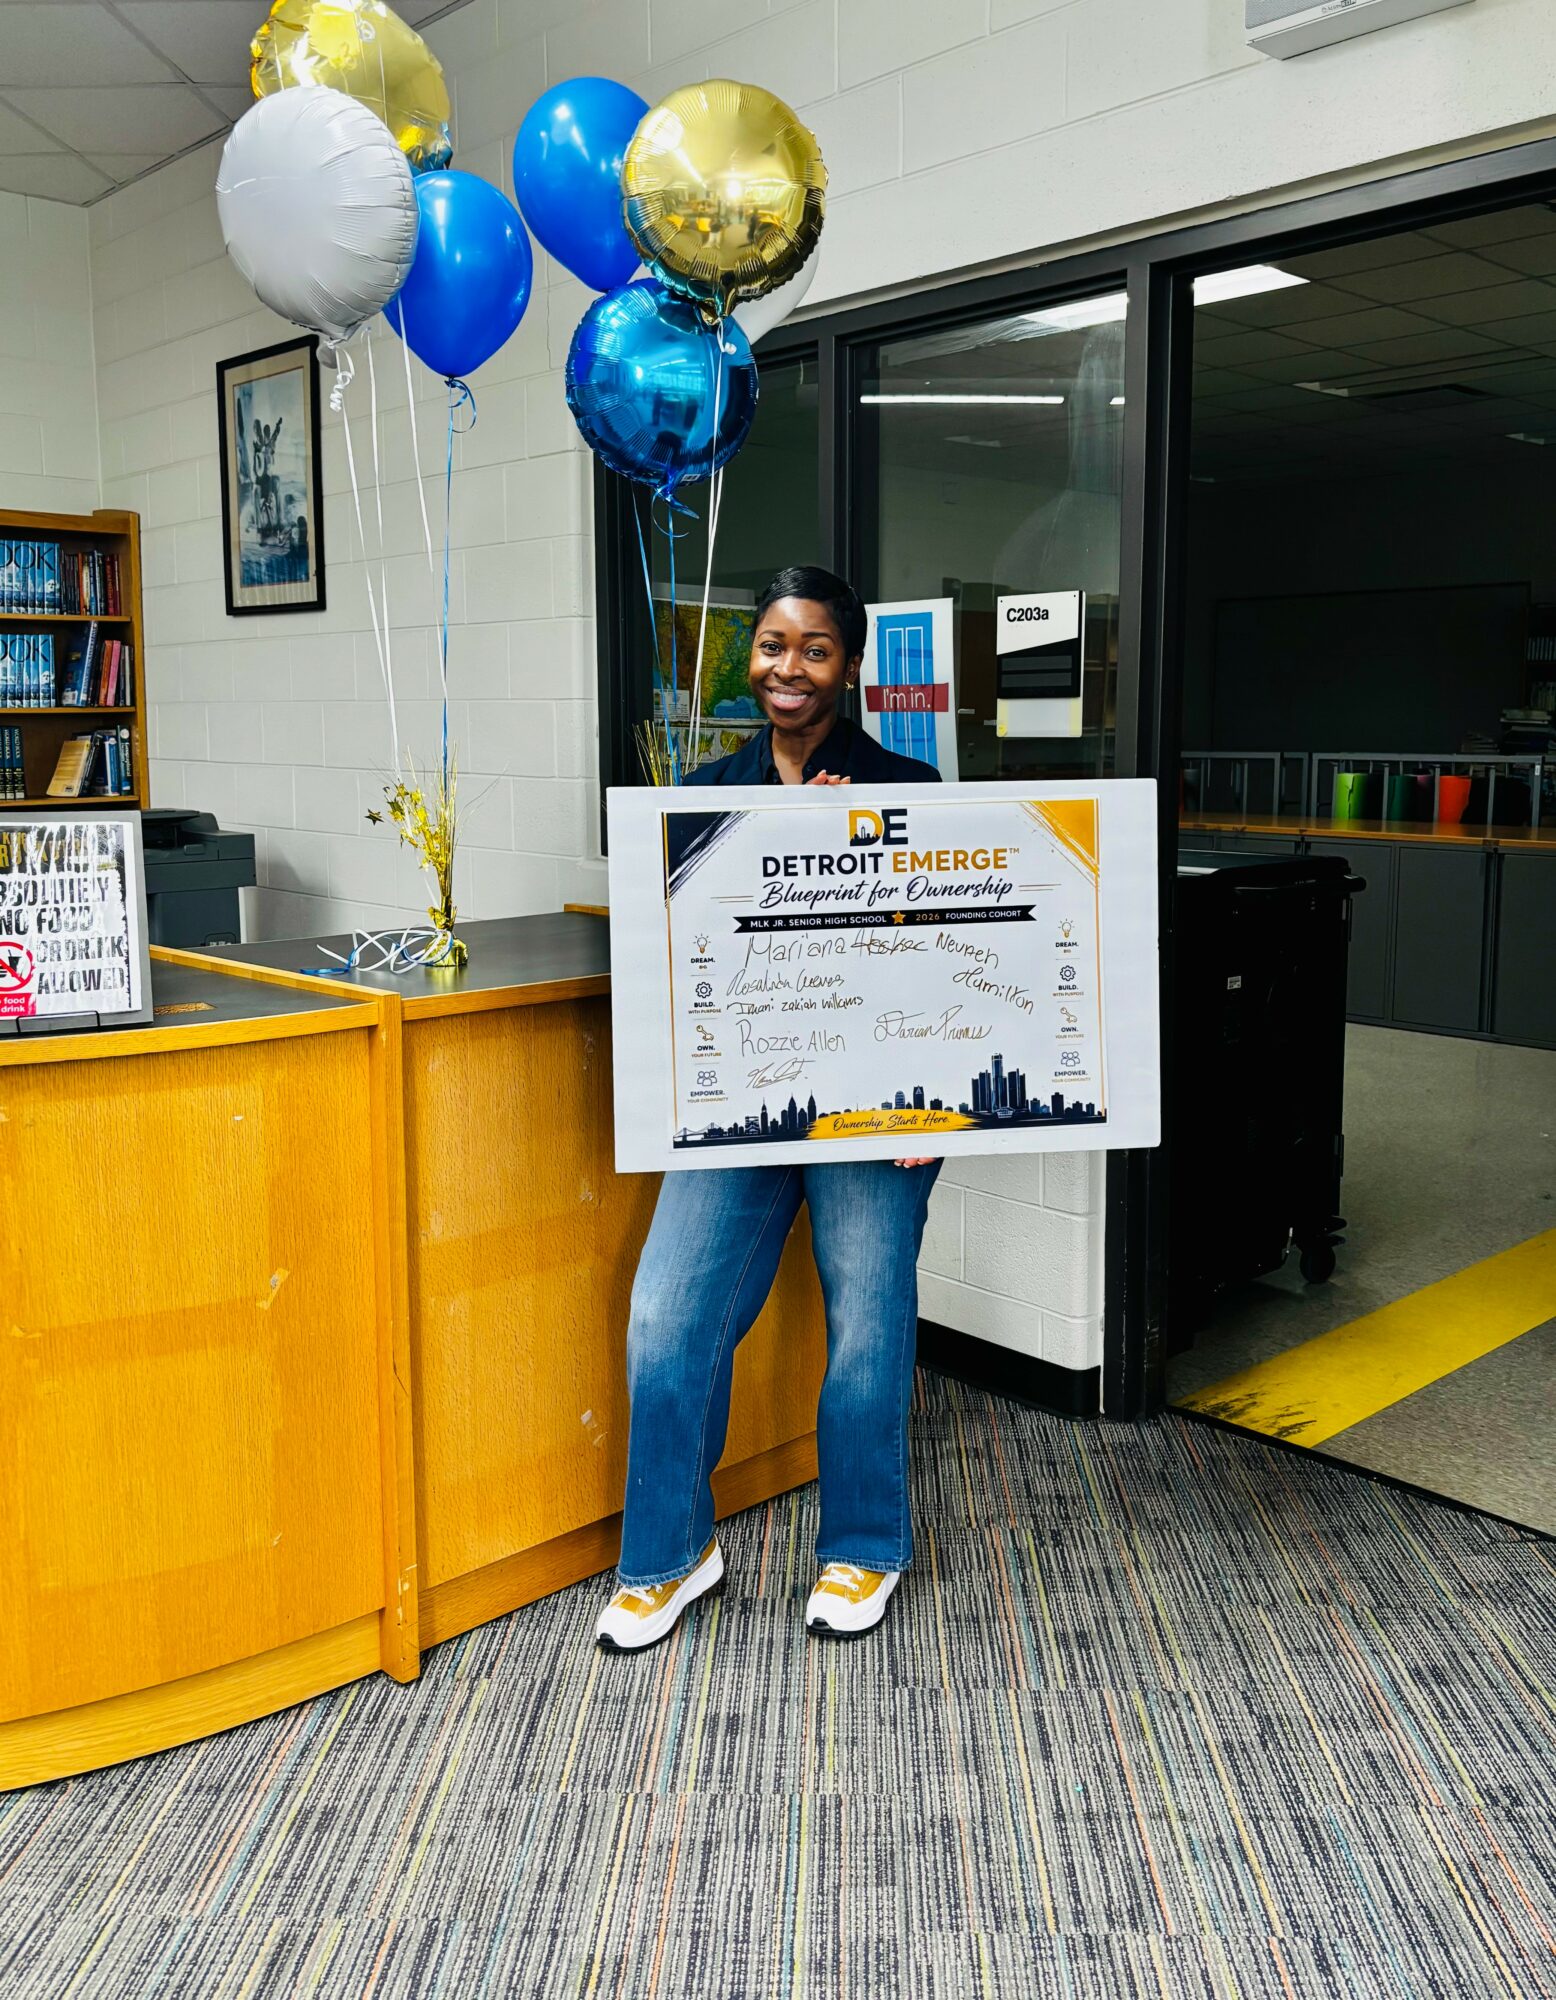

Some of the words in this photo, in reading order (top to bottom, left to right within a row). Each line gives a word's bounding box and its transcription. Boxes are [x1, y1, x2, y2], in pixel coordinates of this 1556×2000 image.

[1006, 606, 1049, 622] C203a
[883, 687, 907, 709] I'm
[910, 686, 931, 709] in.
[762, 852, 884, 878] DETROIT
[759, 880, 870, 911] Blueprint
[867, 880, 900, 907] for
[906, 875, 1013, 903] Ownership
[750, 919, 770, 928] MLK
[772, 919, 786, 927] JR.
[789, 917, 822, 926] SENIOR
[824, 916, 847, 925] HIGH
[849, 915, 887, 924] SCHOOL
[915, 913, 940, 921] 2026
[945, 911, 987, 920] FOUNDING
[988, 910, 1021, 918] COHORT
[745, 933, 846, 968] Mariana
[0, 1005, 25, 1014] drink
[3, 997, 25, 1005] food
[807, 1029, 846, 1052] Allen
[1054, 1069, 1089, 1077] EMPOWER.
[690, 1089, 726, 1098] EMPOWER.
[833, 1117, 884, 1131] Ownership
[886, 1114, 919, 1129] Starts
